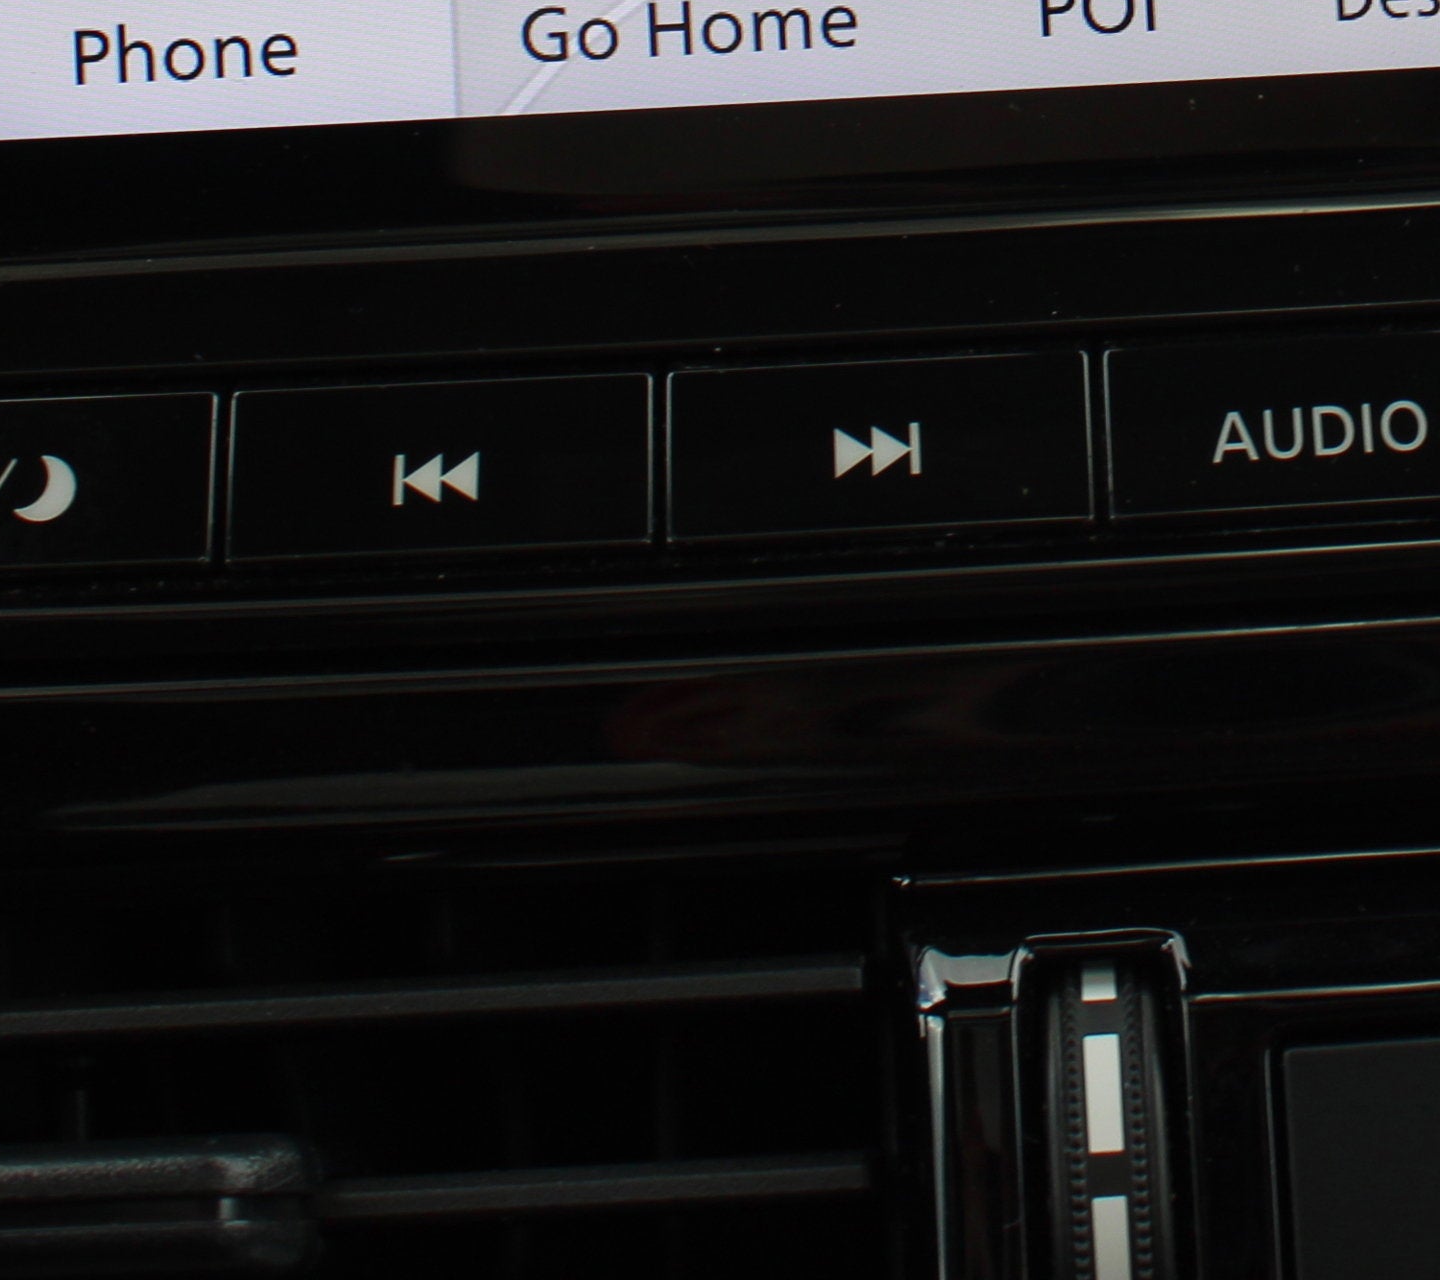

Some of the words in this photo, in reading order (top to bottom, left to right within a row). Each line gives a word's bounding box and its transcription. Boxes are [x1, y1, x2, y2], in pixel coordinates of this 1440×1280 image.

[74, 27, 298, 85] Phone
[521, 5, 620, 63] Go
[646, 0, 859, 58] Home
[1212, 399, 1428, 465] AUDIO
